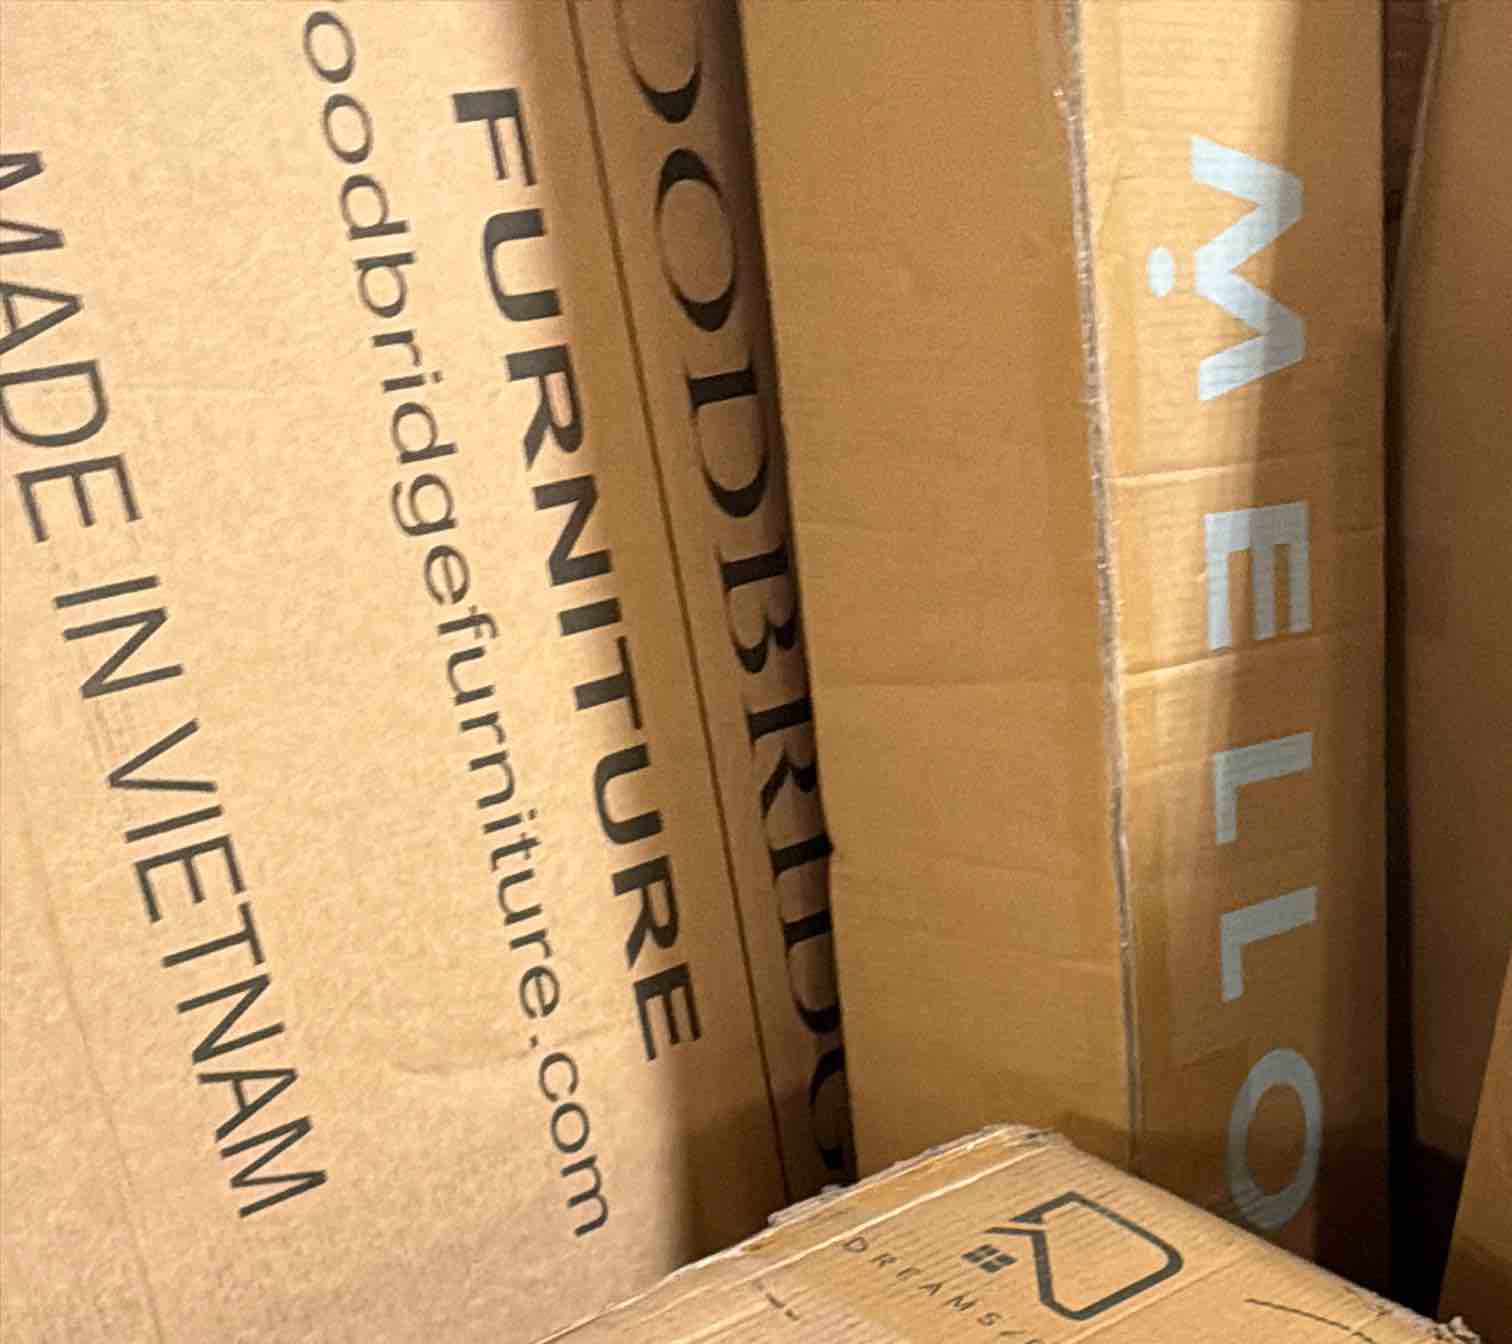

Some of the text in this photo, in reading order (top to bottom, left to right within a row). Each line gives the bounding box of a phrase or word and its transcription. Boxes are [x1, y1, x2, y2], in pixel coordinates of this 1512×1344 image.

[52, 574, 186, 702] IN
[302, 10, 611, 1240] oodbridgefurniture.com
[451, 86, 702, 1062] FURNITURE
[106, 718, 328, 1218] VIETNAM
